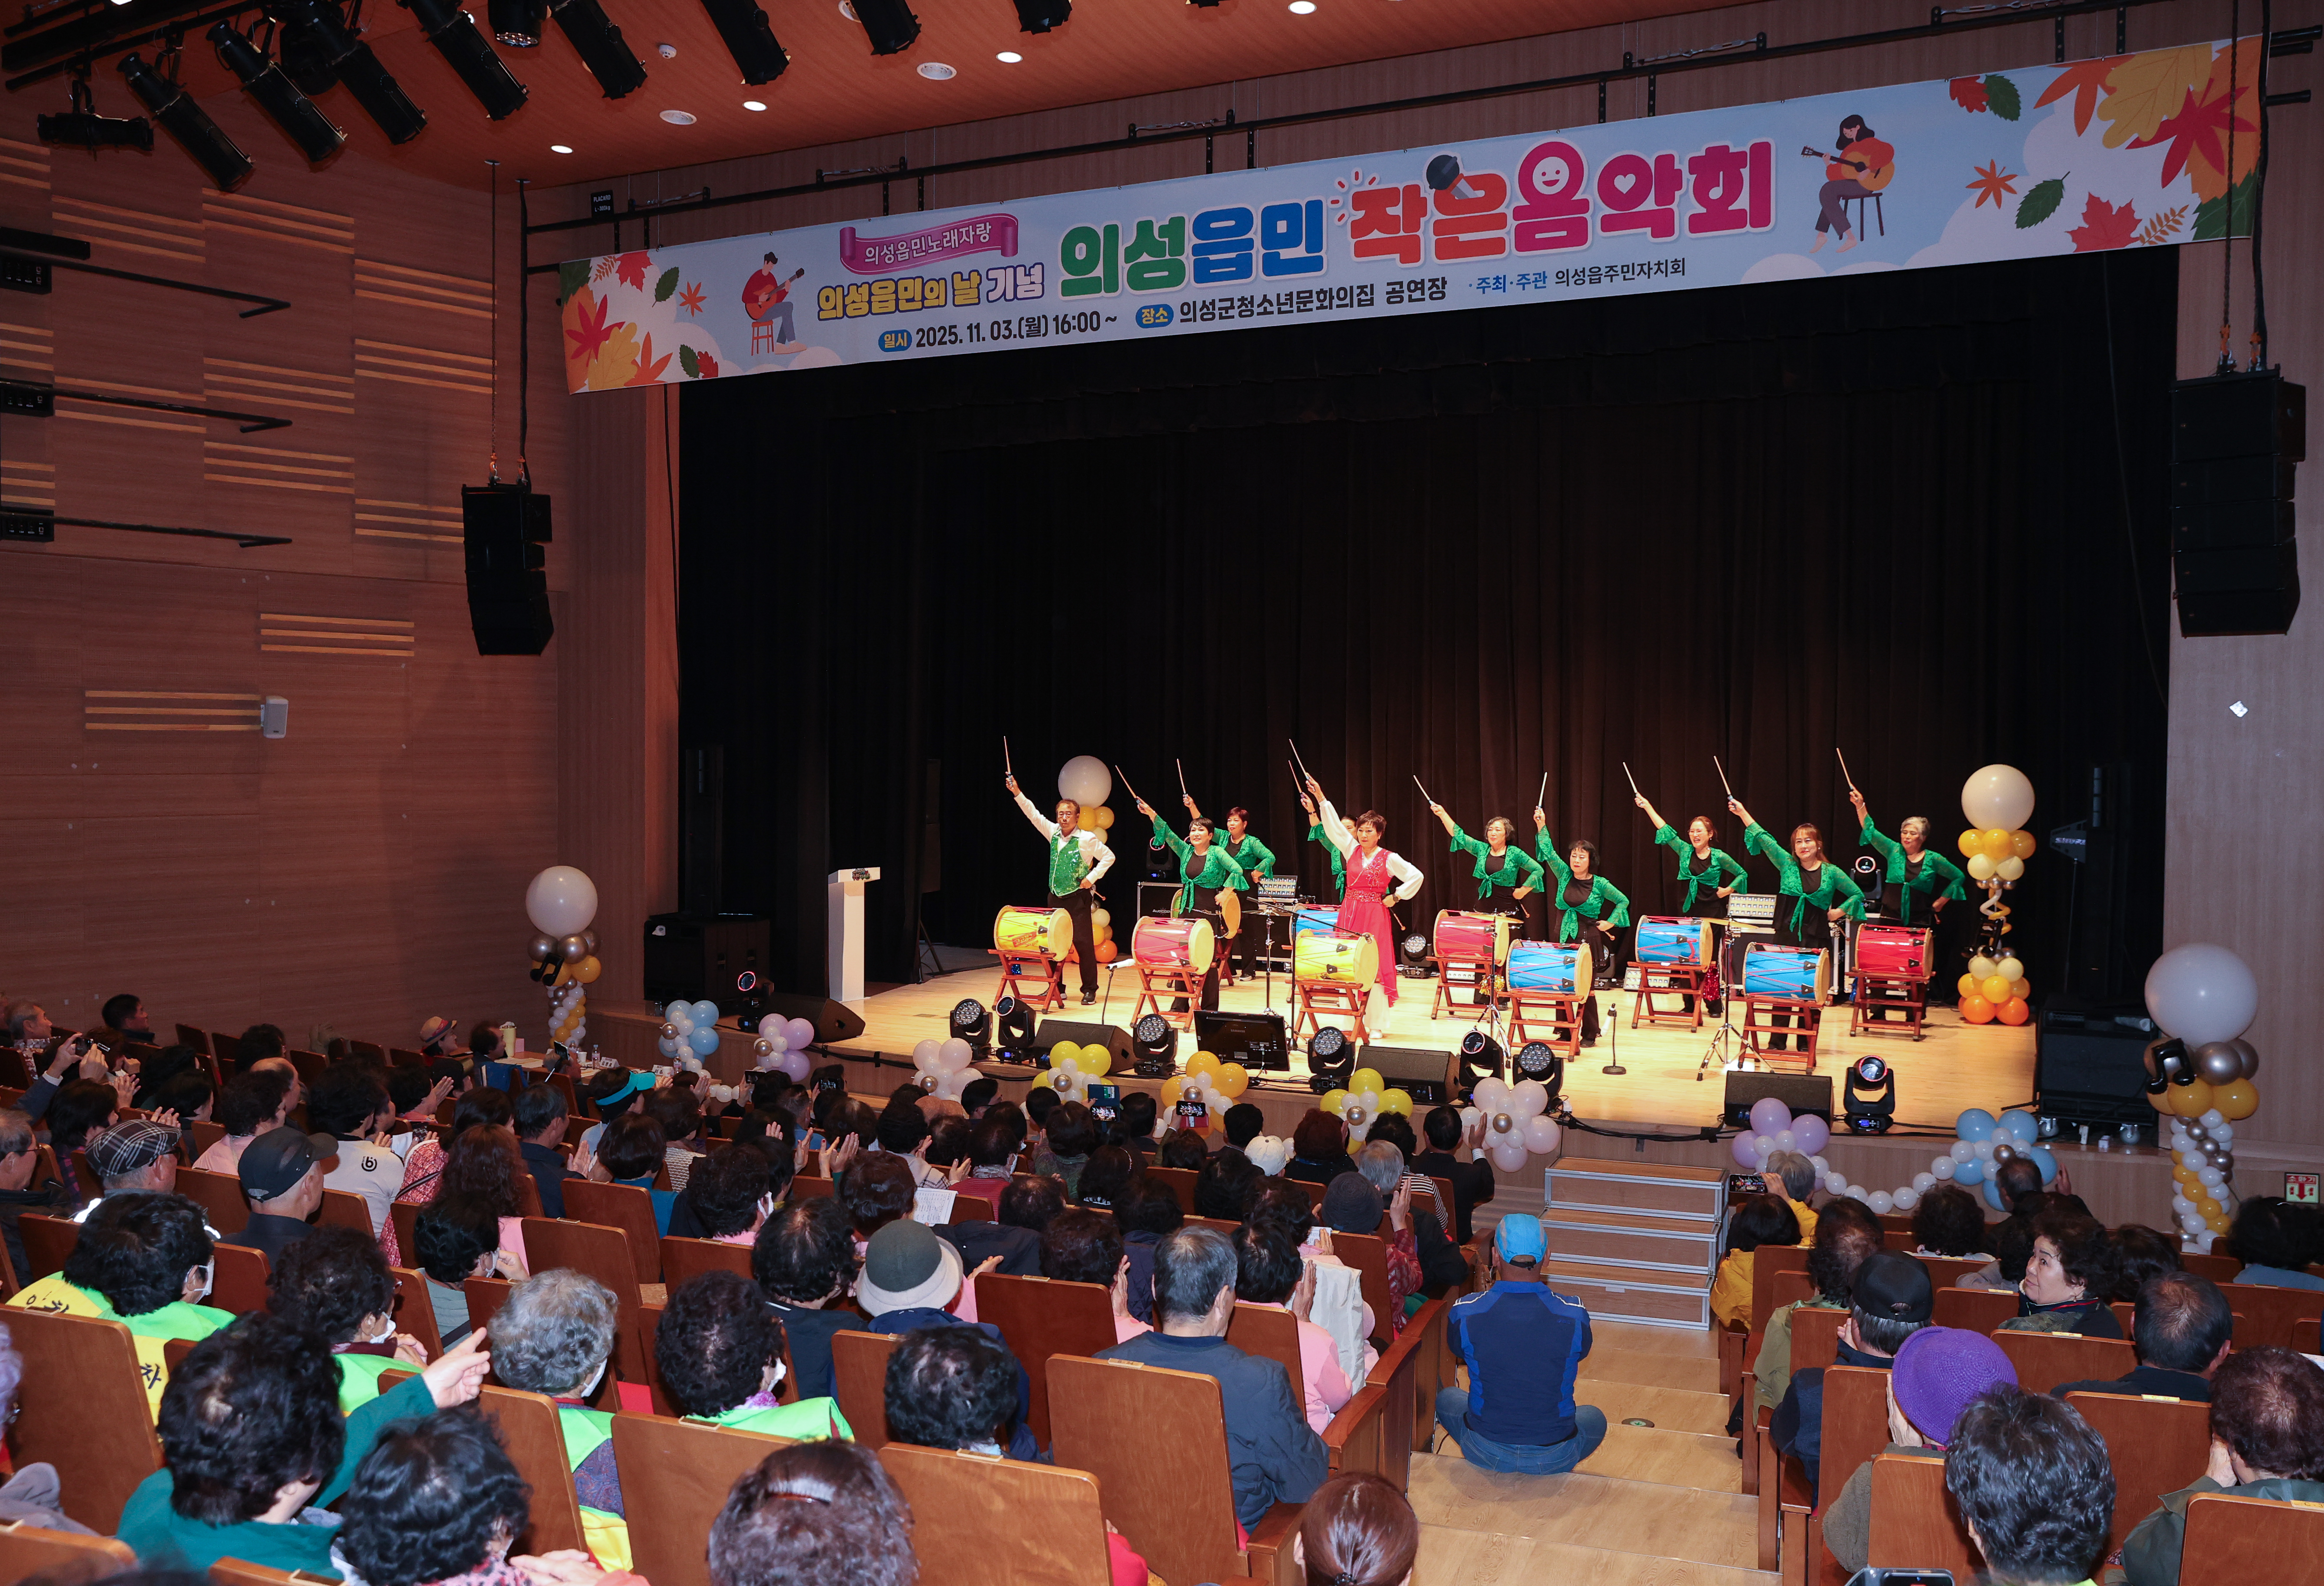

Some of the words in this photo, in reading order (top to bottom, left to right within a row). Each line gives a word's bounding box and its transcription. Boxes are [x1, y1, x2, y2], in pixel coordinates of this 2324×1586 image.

[865, 222, 992, 265] 의성읍민노래자랑
[1060, 199, 1324, 297] 의성읍민
[818, 277, 947, 320] 의성읍민의
[952, 270, 982, 307] 날
[986, 263, 1044, 303] 기념
[884, 332, 908, 348] 일시
[916, 325, 963, 347] 2025.
[967, 323, 986, 343] 11.
[1141, 305, 1168, 324] 장소
[1180, 284, 1375, 323] 의성군청소년문화의집
[1386, 277, 1447, 305] 공연장
[1555, 258, 1686, 287] 의성읍주민자치회
